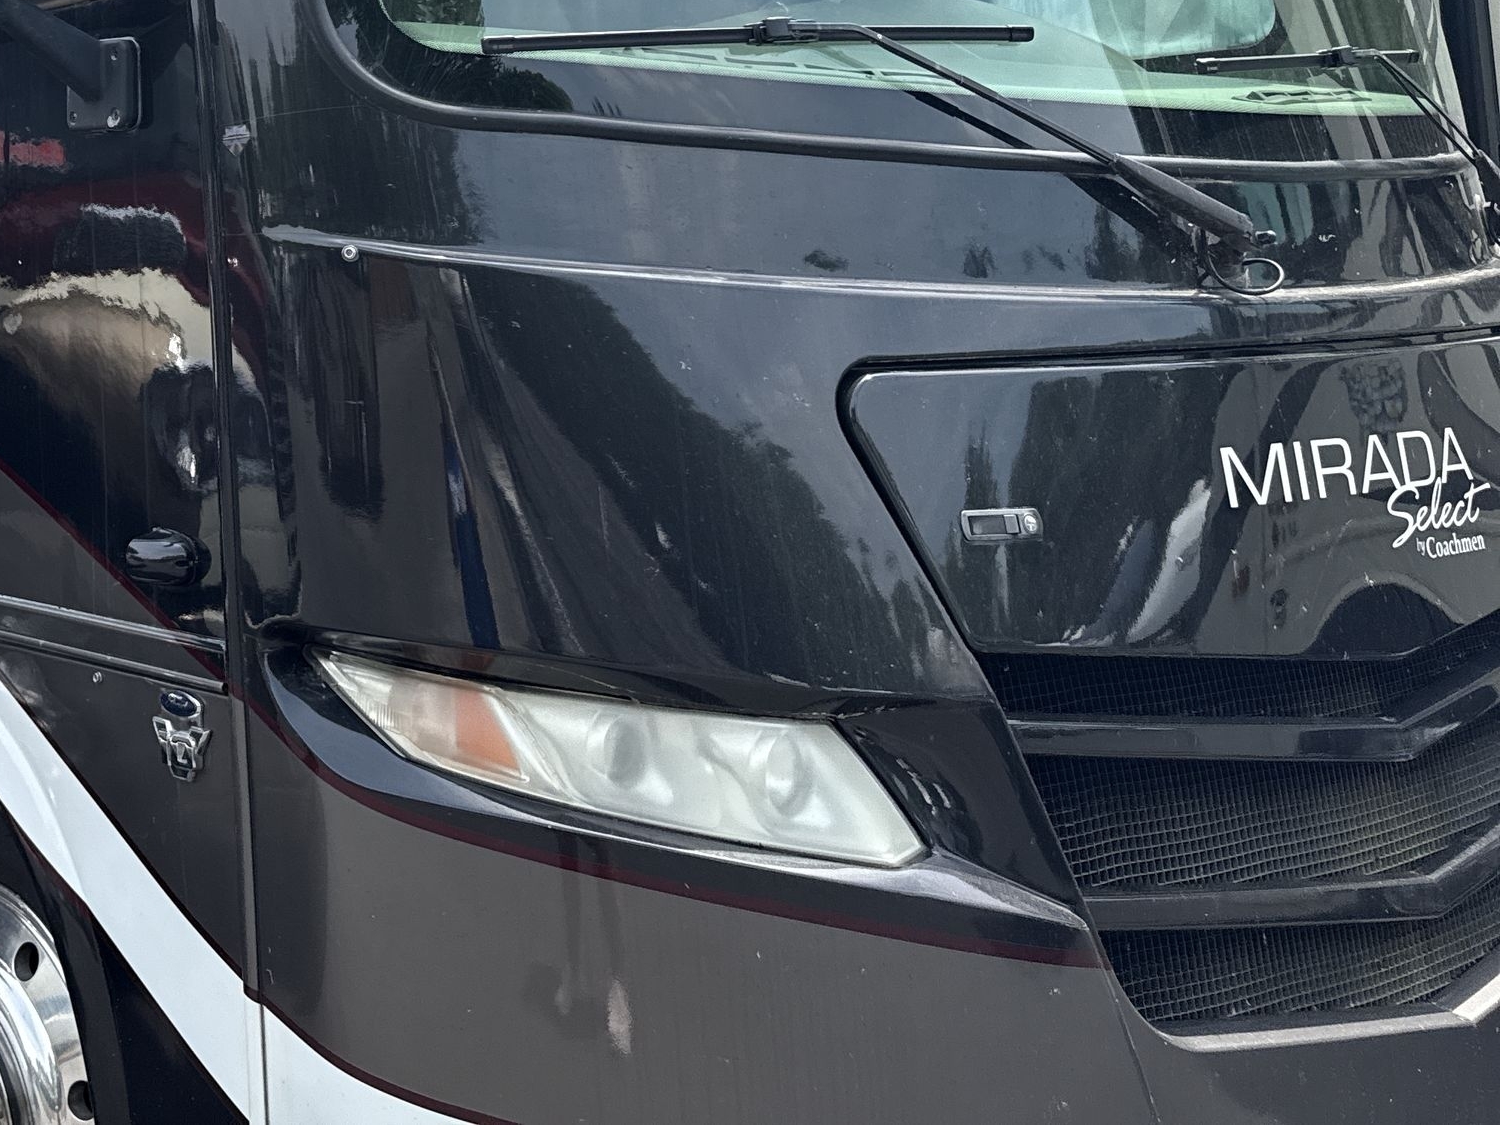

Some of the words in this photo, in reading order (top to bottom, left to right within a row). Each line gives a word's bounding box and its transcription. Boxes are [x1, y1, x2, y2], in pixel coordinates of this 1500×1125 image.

[1219, 427, 1474, 508] MIRADA
[1386, 476, 1491, 548] Select
[1415, 537, 1426, 557] by
[1426, 532, 1487, 559] Coachmen
